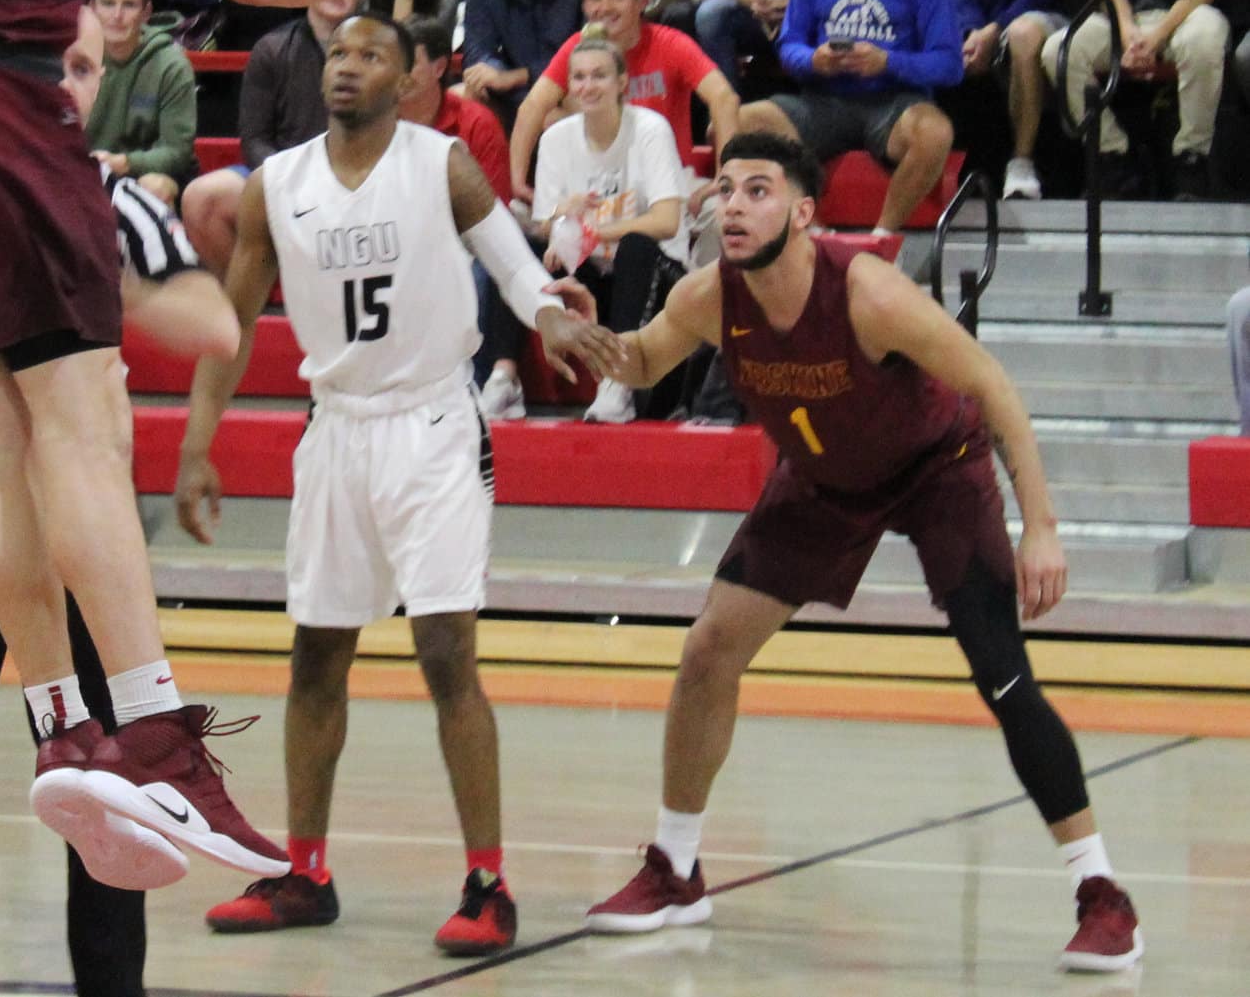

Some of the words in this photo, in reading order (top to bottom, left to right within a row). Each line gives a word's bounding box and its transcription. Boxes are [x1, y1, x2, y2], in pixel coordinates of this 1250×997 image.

[316, 220, 400, 270] NGU
[343, 273, 393, 343] 15
[790, 406, 825, 455] 1
